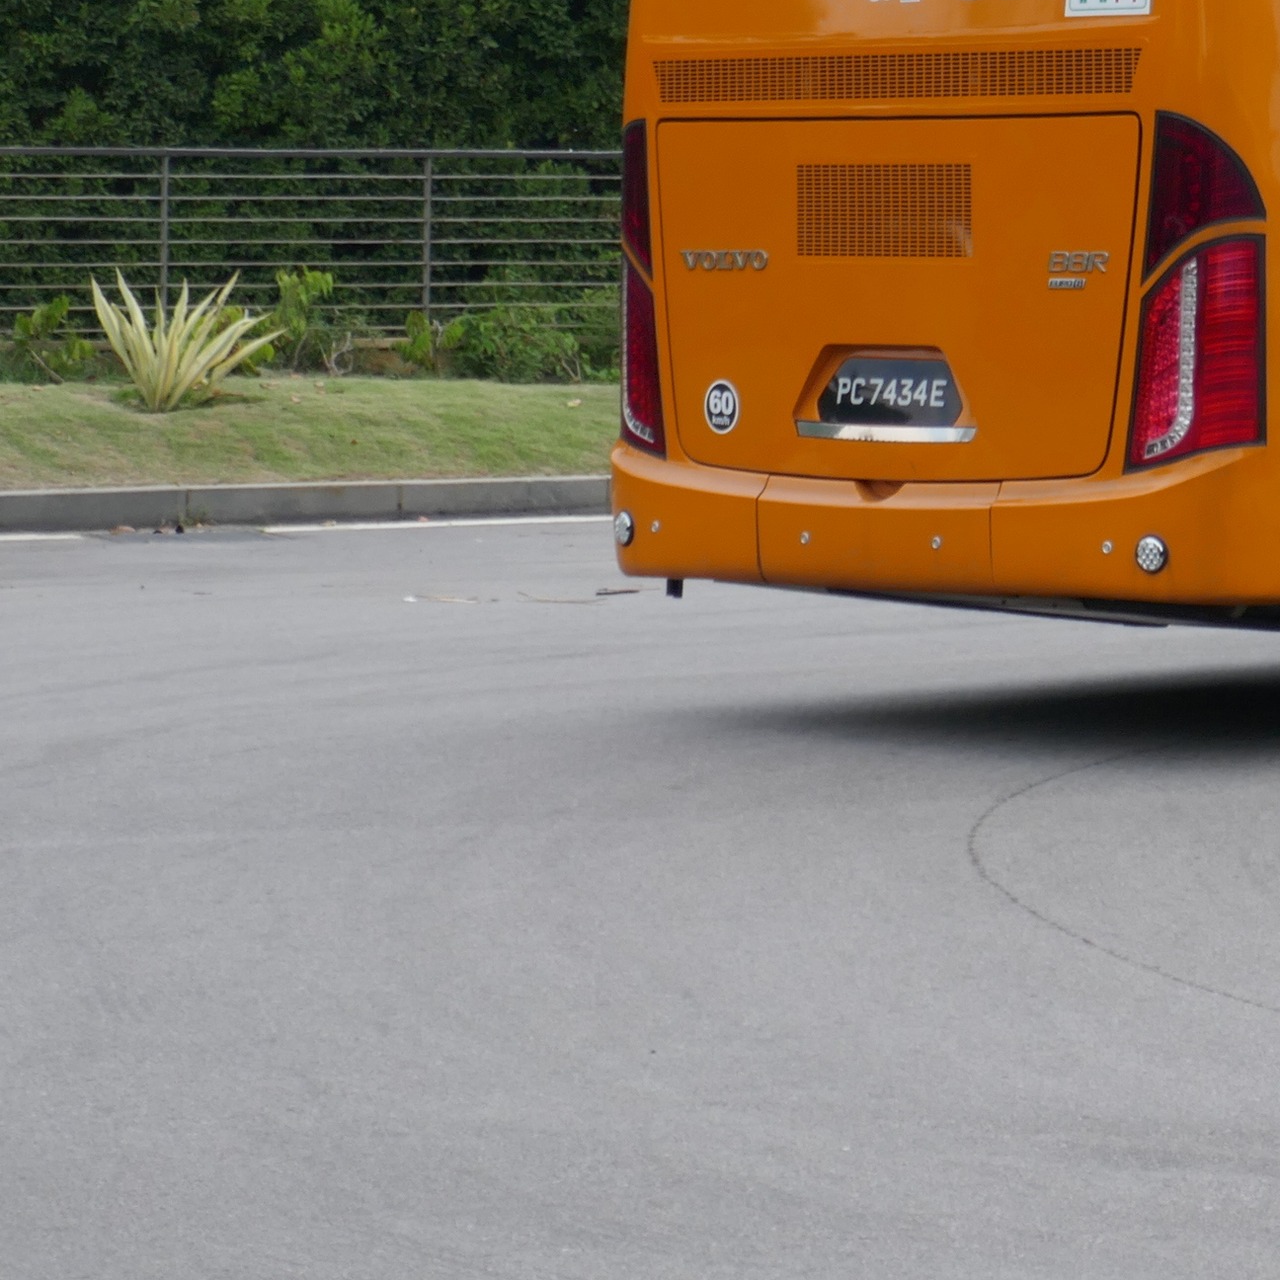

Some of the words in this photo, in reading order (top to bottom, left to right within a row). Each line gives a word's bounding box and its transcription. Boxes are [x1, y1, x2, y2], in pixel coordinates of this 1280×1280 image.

[680, 250, 769, 270] VOLVO
[1049, 251, 1109, 273] B8R
[709, 389, 734, 416] 60
